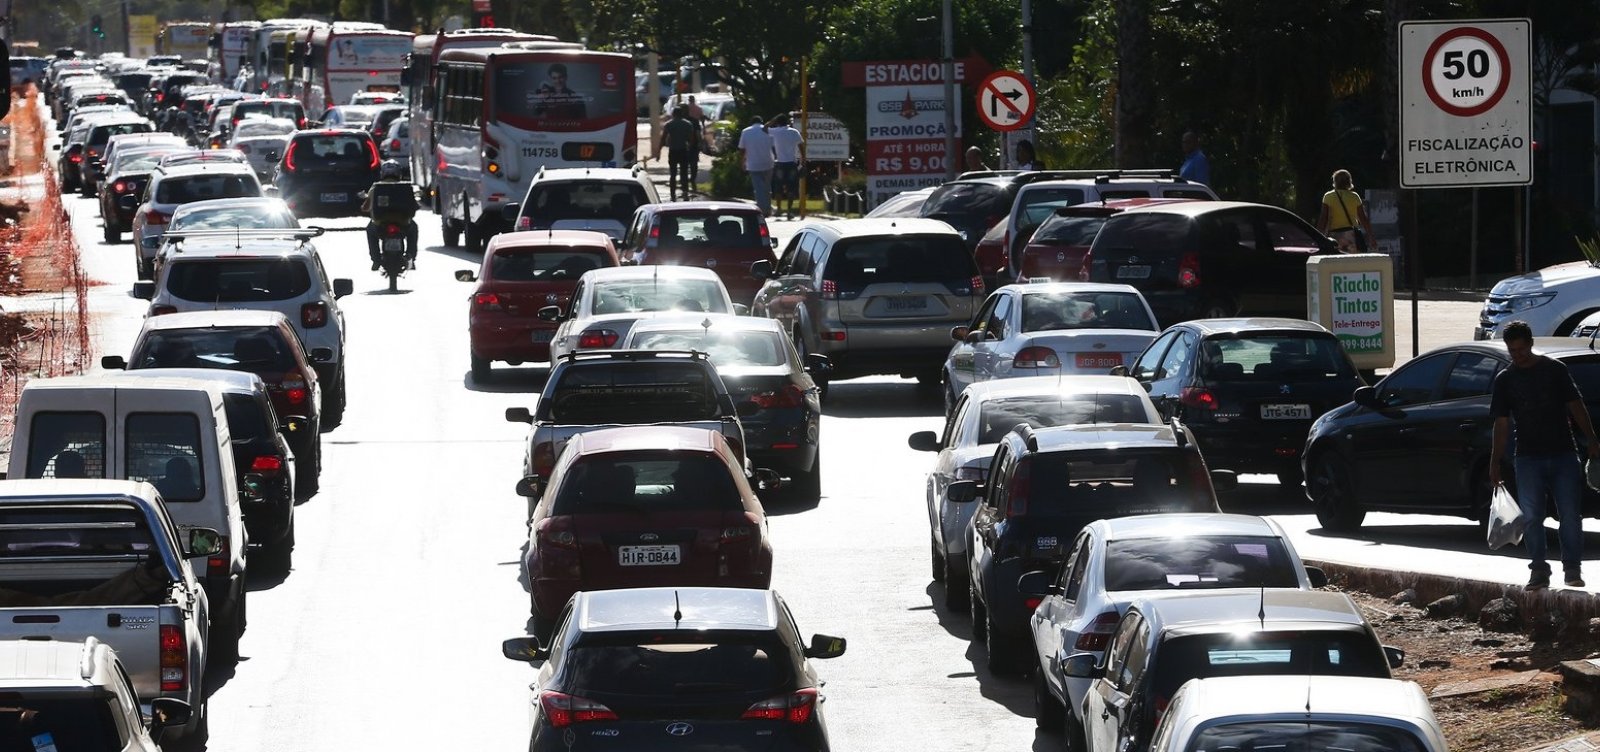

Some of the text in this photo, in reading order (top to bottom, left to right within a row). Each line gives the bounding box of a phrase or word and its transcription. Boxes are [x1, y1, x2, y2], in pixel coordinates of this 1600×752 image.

[1443, 49, 1490, 80] 50
[1452, 86, 1484, 98] km/h
[870, 122, 958, 137] PROMOÇÃ
[883, 143, 903, 153] ATÉ
[906, 143, 913, 153] 1
[1408, 134, 1524, 152] FISCALIZAÇÃO
[521, 147, 559, 158] 114758
[875, 158, 903, 171] R$
[1415, 157, 1516, 174] ELETRÔNICA
[875, 178, 914, 188] DEMAIS
[1333, 274, 1379, 293] Riacho
[1335, 297, 1378, 314] Tintas
[1334, 320, 1380, 329] Tele-Entrega
[1264, 409, 1307, 417] JTG-4571
[623, 552, 677, 563] HIR-0844
